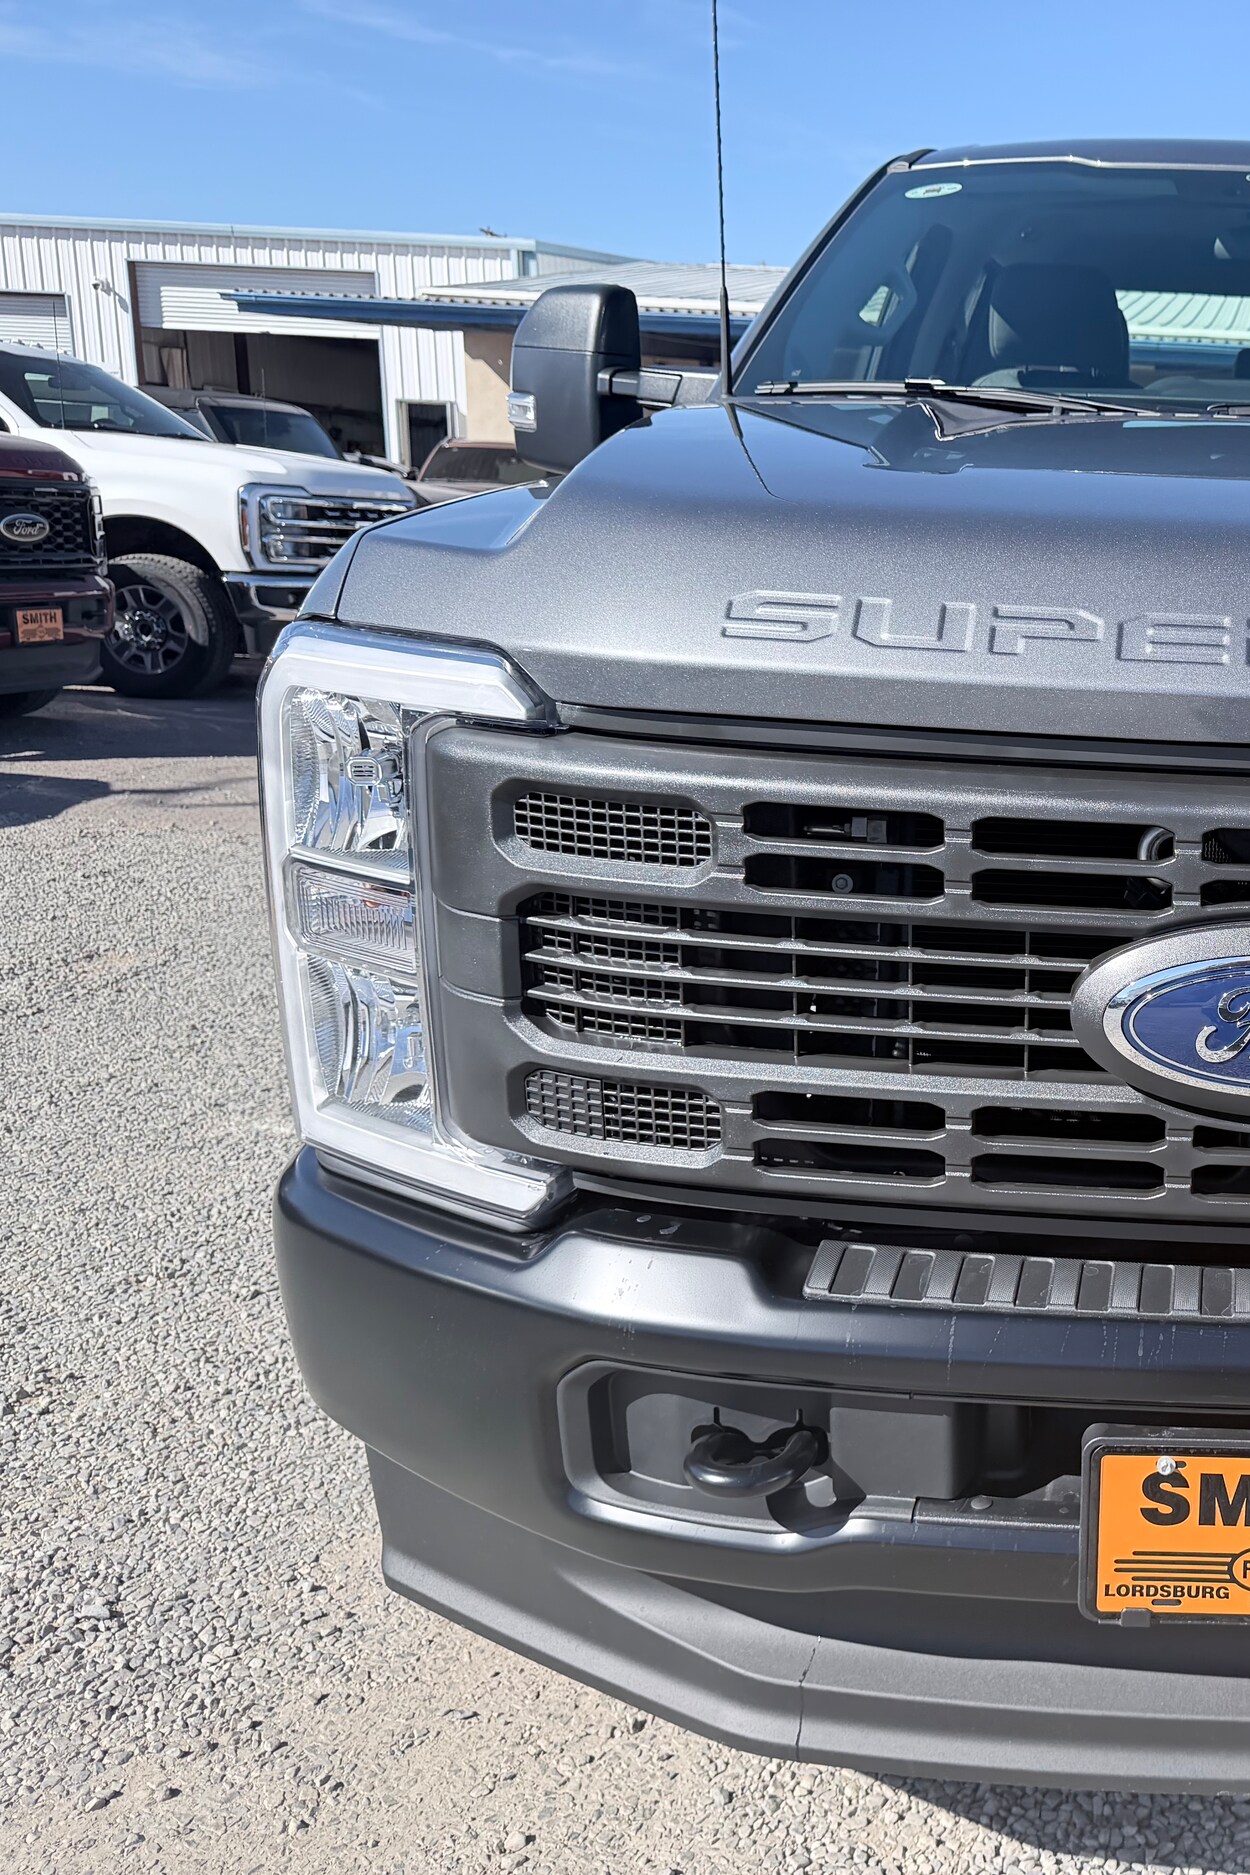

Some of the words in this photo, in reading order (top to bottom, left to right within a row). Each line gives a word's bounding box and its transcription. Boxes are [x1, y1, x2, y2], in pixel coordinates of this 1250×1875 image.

[13, 518, 42, 536] Ford
[22, 611, 57, 625] SMITH
[1103, 1583, 1230, 1600] LORDSBURG
